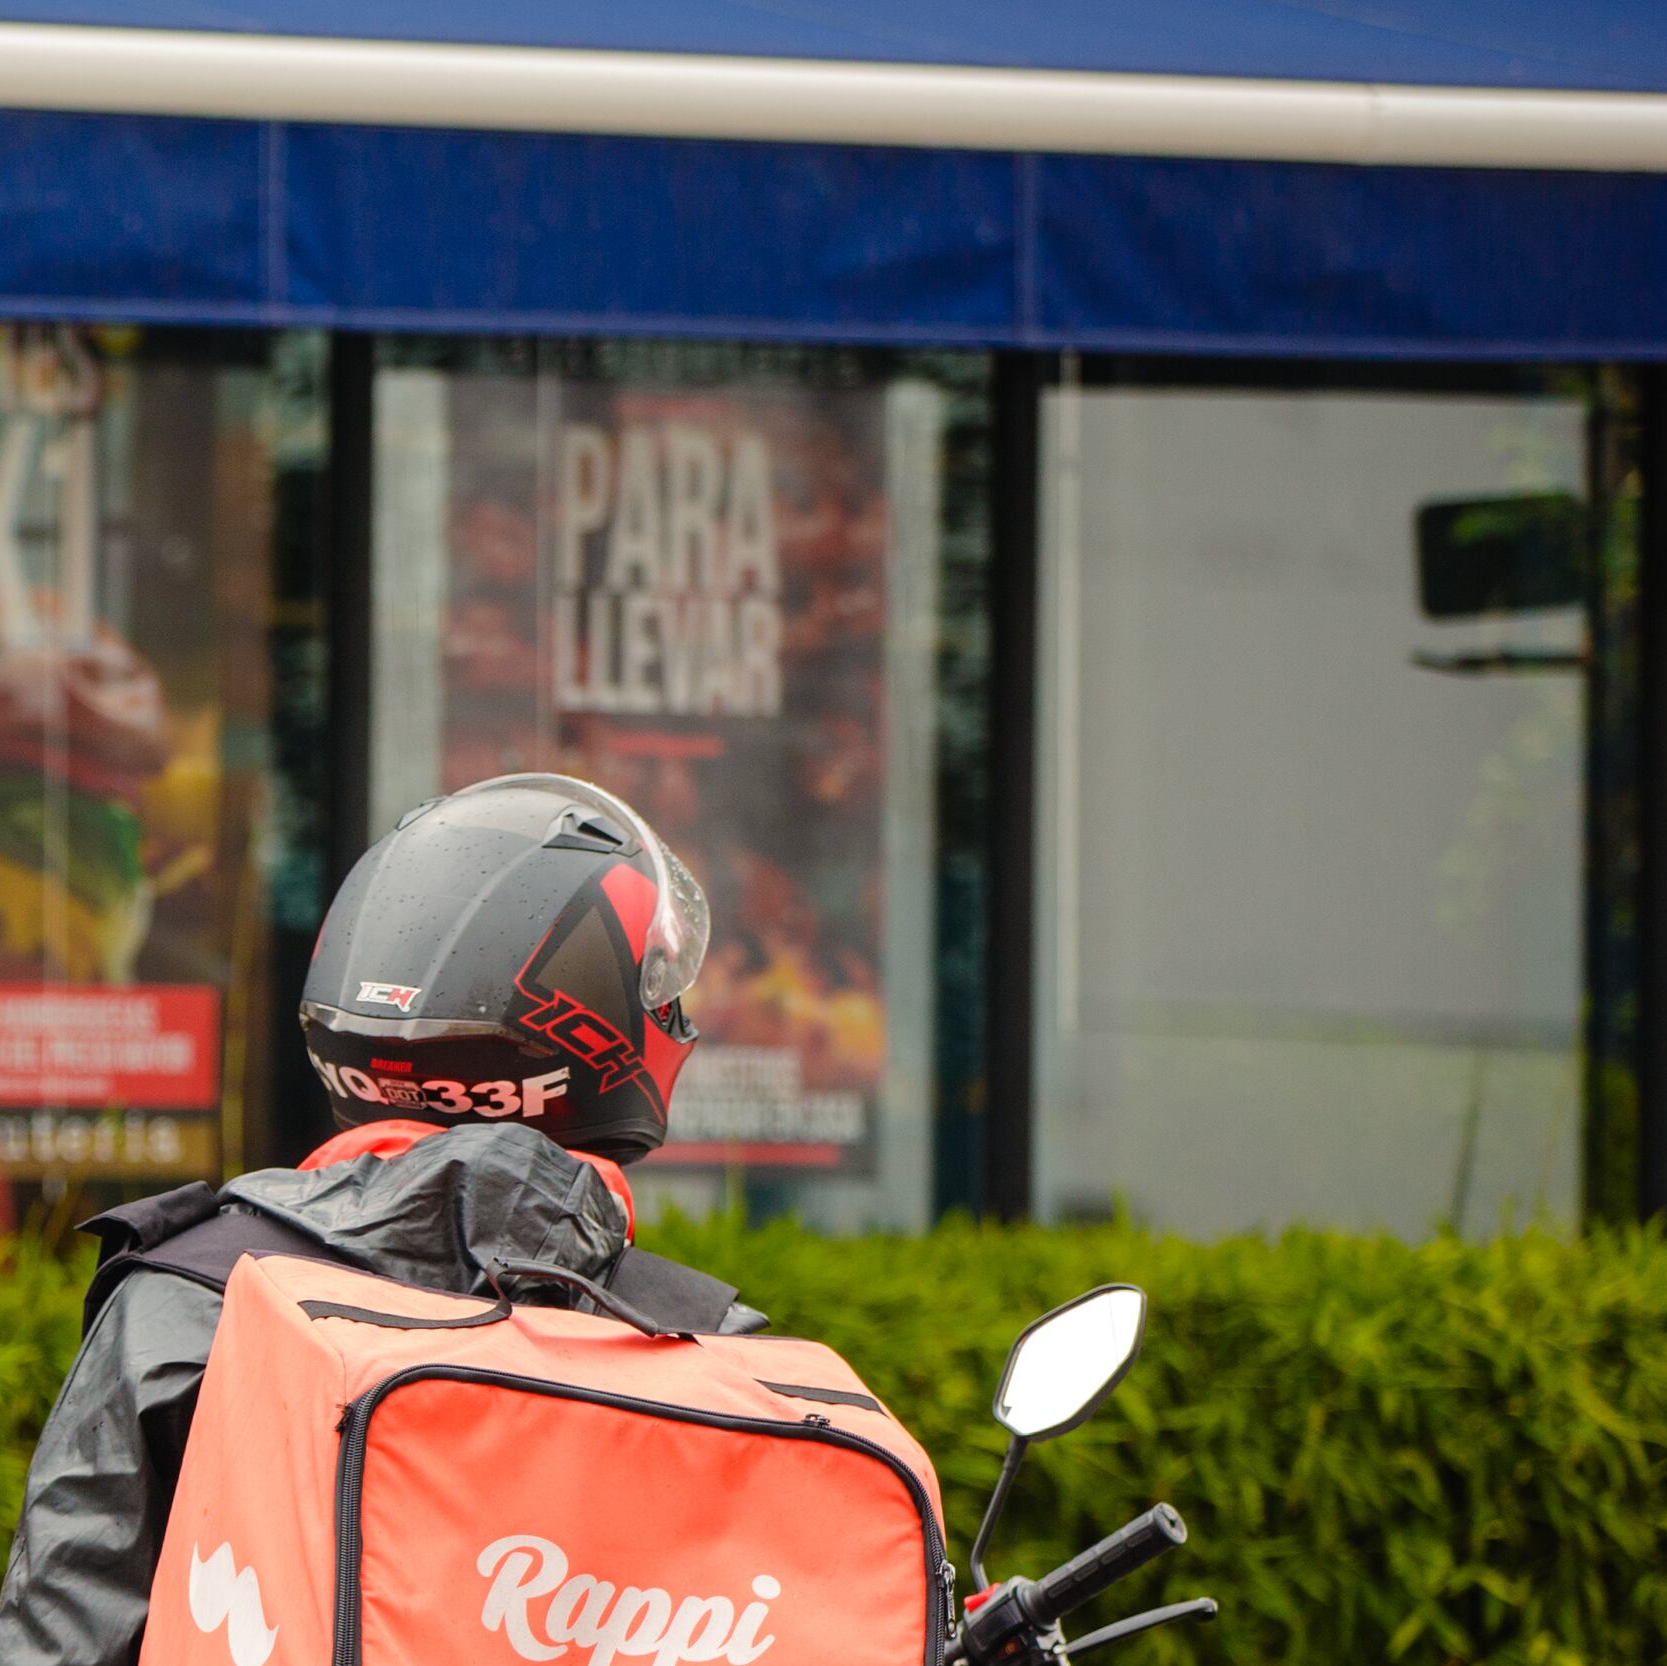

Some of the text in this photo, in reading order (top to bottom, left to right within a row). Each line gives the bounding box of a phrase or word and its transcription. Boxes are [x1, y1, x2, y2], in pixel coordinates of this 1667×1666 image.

[559, 422, 781, 591] PARA
[553, 590, 784, 718] LLEVAR
[421, 1066, 571, 1118] 33F
